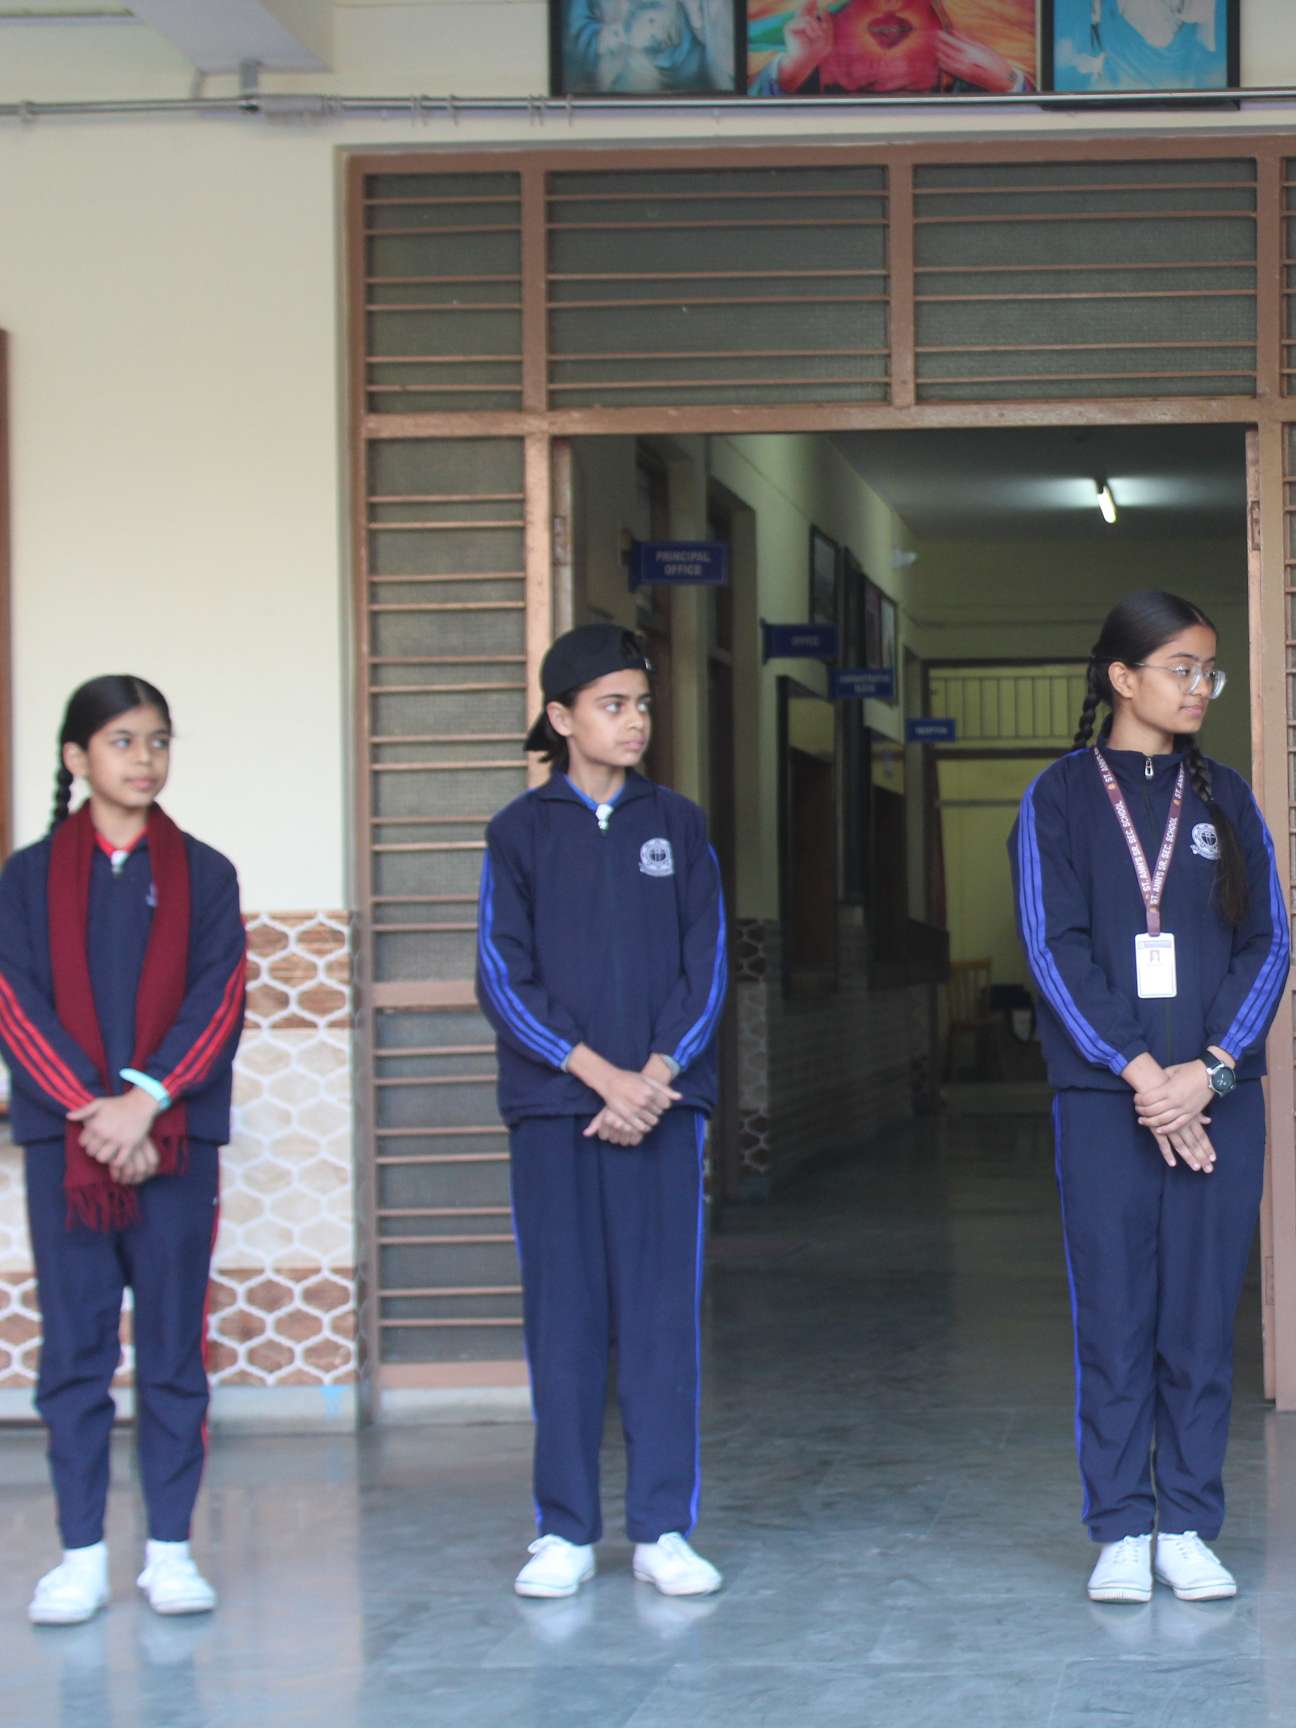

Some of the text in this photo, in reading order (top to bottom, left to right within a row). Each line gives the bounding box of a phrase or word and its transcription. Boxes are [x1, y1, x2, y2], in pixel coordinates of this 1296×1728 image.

[655, 550, 711, 563] PRINCIPAL
[664, 564, 703, 576] OFFICE
[1115, 800, 1131, 827] SCHOOL
[1152, 871, 1165, 892] ANN'S
[1165, 816, 1178, 843] SCHOOL
[1135, 856, 1148, 879] ANN'S
